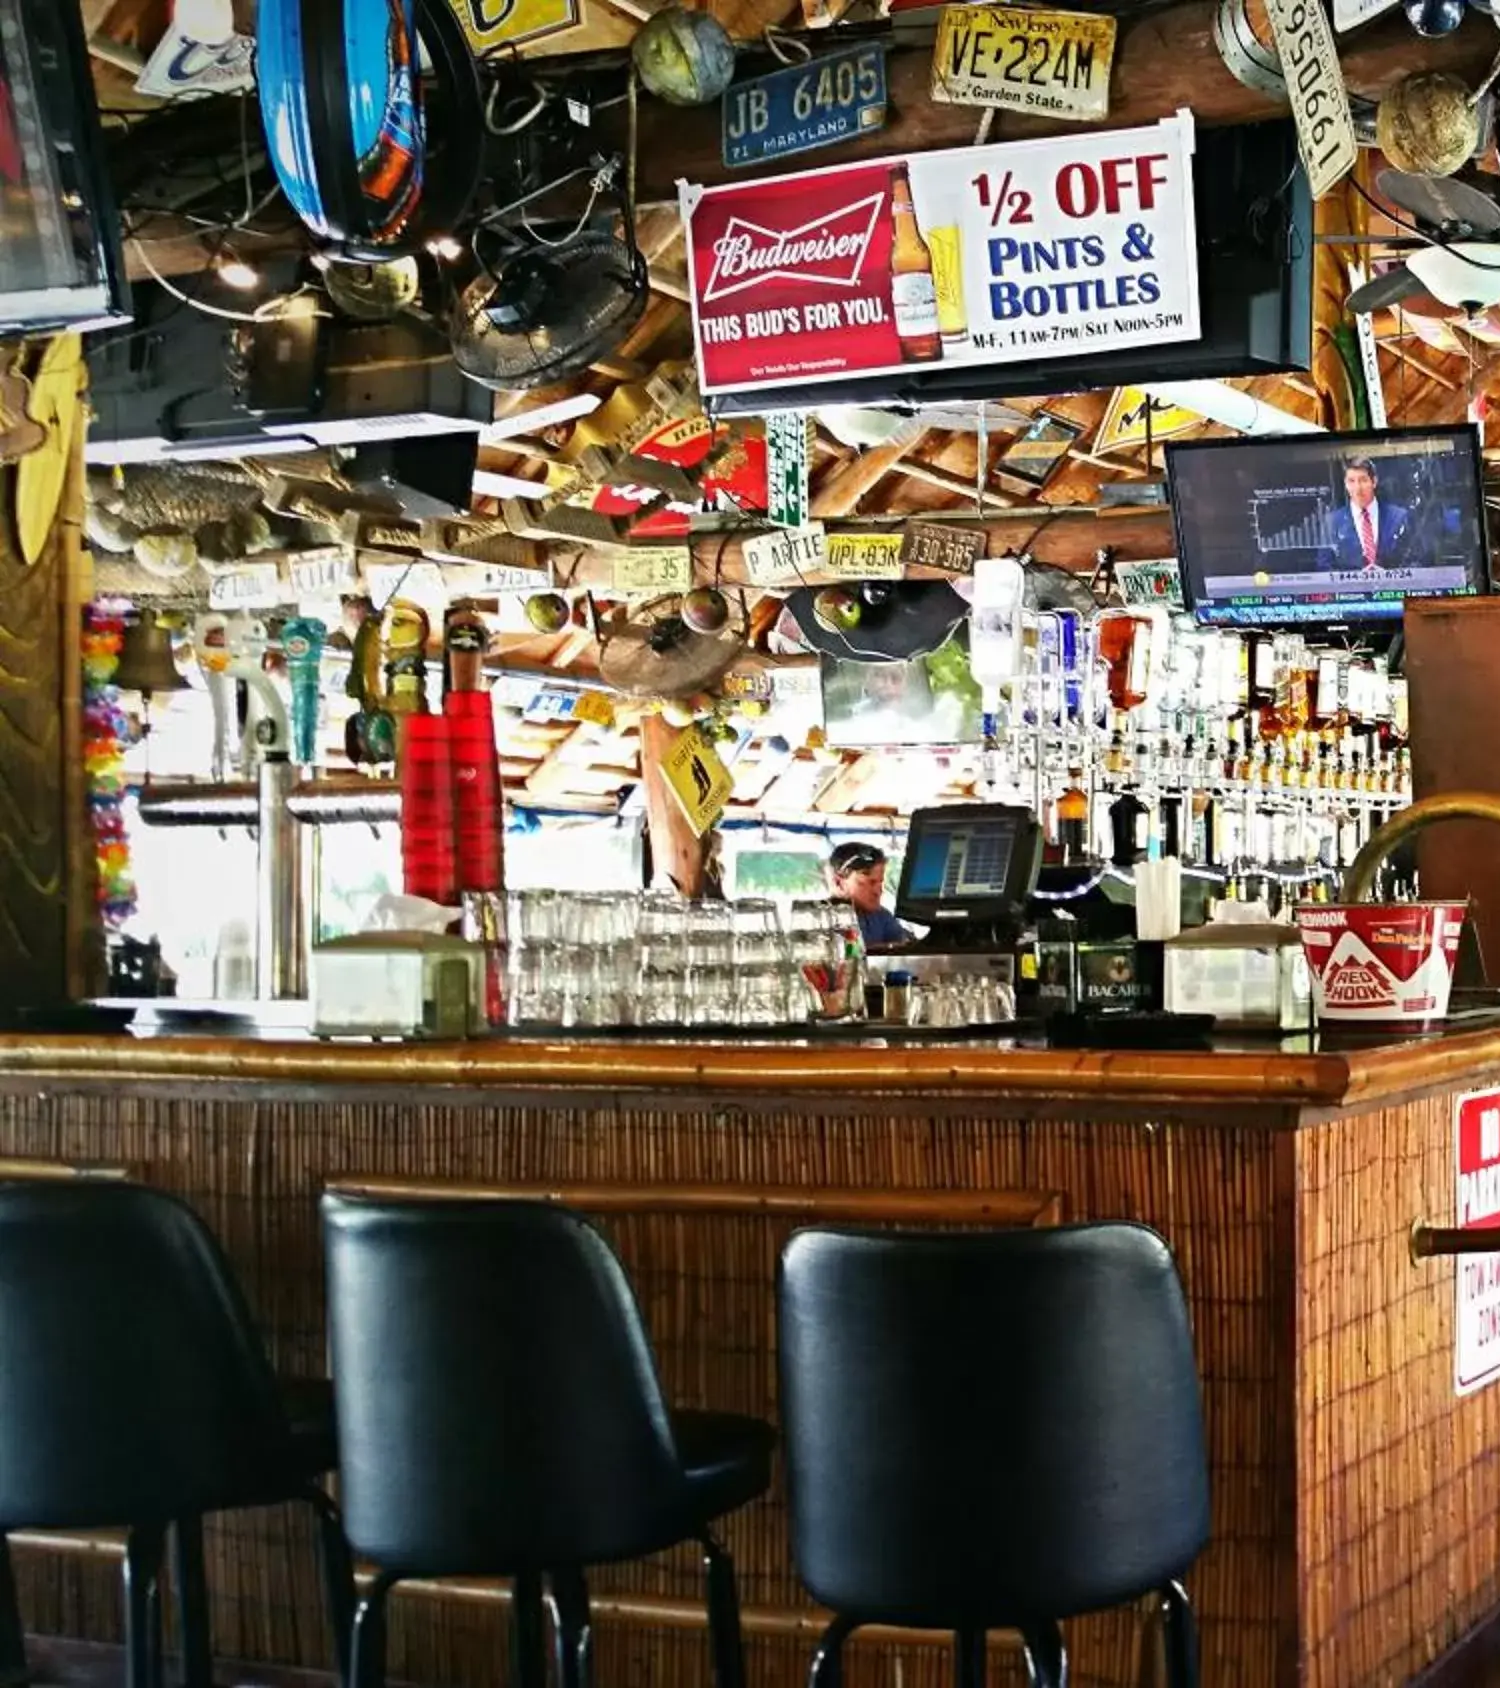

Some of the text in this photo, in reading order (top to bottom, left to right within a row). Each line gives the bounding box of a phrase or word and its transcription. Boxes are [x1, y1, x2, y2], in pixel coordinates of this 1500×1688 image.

[729, 53, 878, 139] JB 6405
[972, 85, 1064, 110] Garden State
[763, 118, 848, 152] MARYLAND
[1055, 153, 1169, 219] OFF
[714, 229, 868, 278] Budweiser
[1121, 222, 1156, 264] &
[700, 296, 890, 344] THIS BUD'S FOR YOU.
[1331, 985, 1386, 1001] HOOK
[1336, 970, 1374, 985] RED
[1464, 1262, 1486, 1301] TOW
